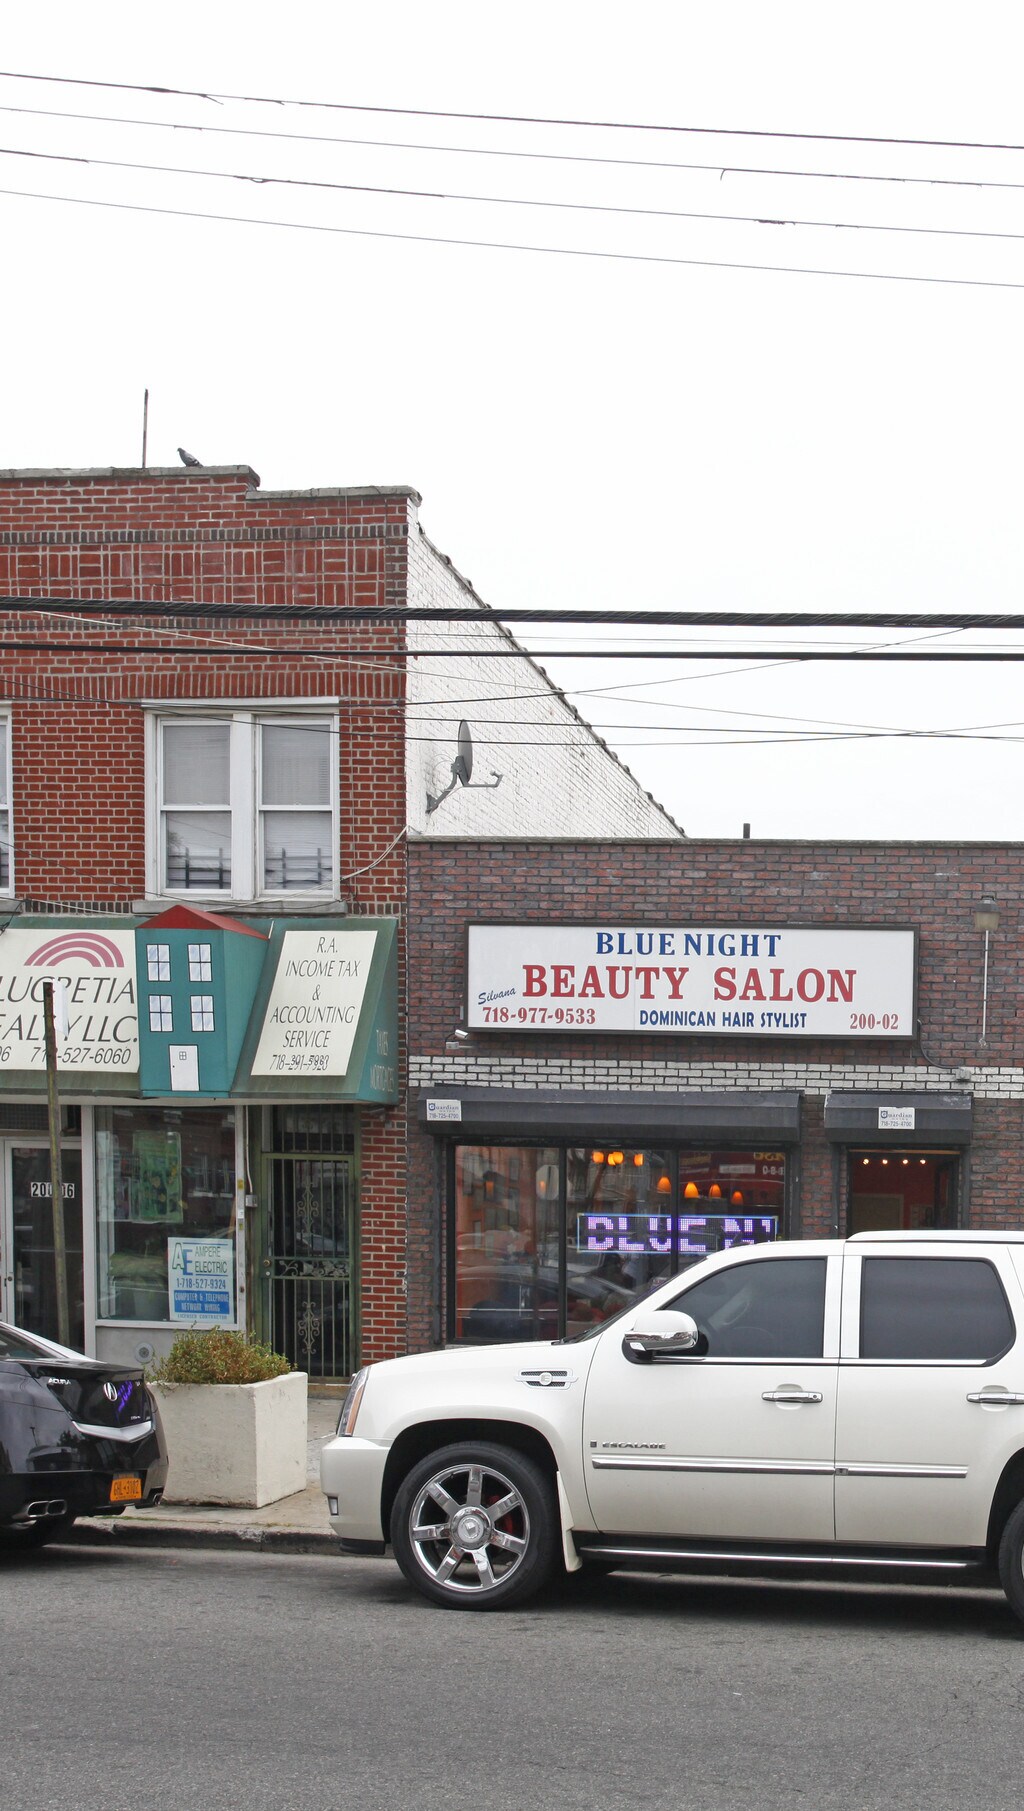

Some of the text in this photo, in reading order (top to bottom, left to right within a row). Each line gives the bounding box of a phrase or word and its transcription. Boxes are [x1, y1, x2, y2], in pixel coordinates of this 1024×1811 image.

[317, 936, 338, 953] R.A.
[596, 932, 782, 957] BLUE NIGHT
[285, 960, 361, 977] INCOME TAX
[0, 976, 135, 1004] UCETIA
[522, 964, 857, 1003] BEAUTY SALON
[312, 984, 321, 1001] &
[477, 987, 517, 1005] Silvana
[270, 1006, 356, 1024] ACCOUNTING
[482, 1007, 596, 1024] 718-977-9533
[639, 1010, 807, 1028] DOMINICAN HAIR STYLIST
[850, 1013, 899, 1030] 200-02
[82, 1015, 138, 1043] LLC.
[283, 1030, 331, 1048] SERVICE
[0, 1045, 12, 1062] 6
[31, 1046, 132, 1065] 71-527-6060
[428, 1103, 459, 1111] Guardian
[881, 1110, 912, 1119] Guardian
[588, 1216, 706, 1252] BLUE
[195, 1246, 221, 1257] AMPERE
[195, 1261, 227, 1273] ELECTRIC
[177, 1278, 226, 1289] 1-718-527-9324
